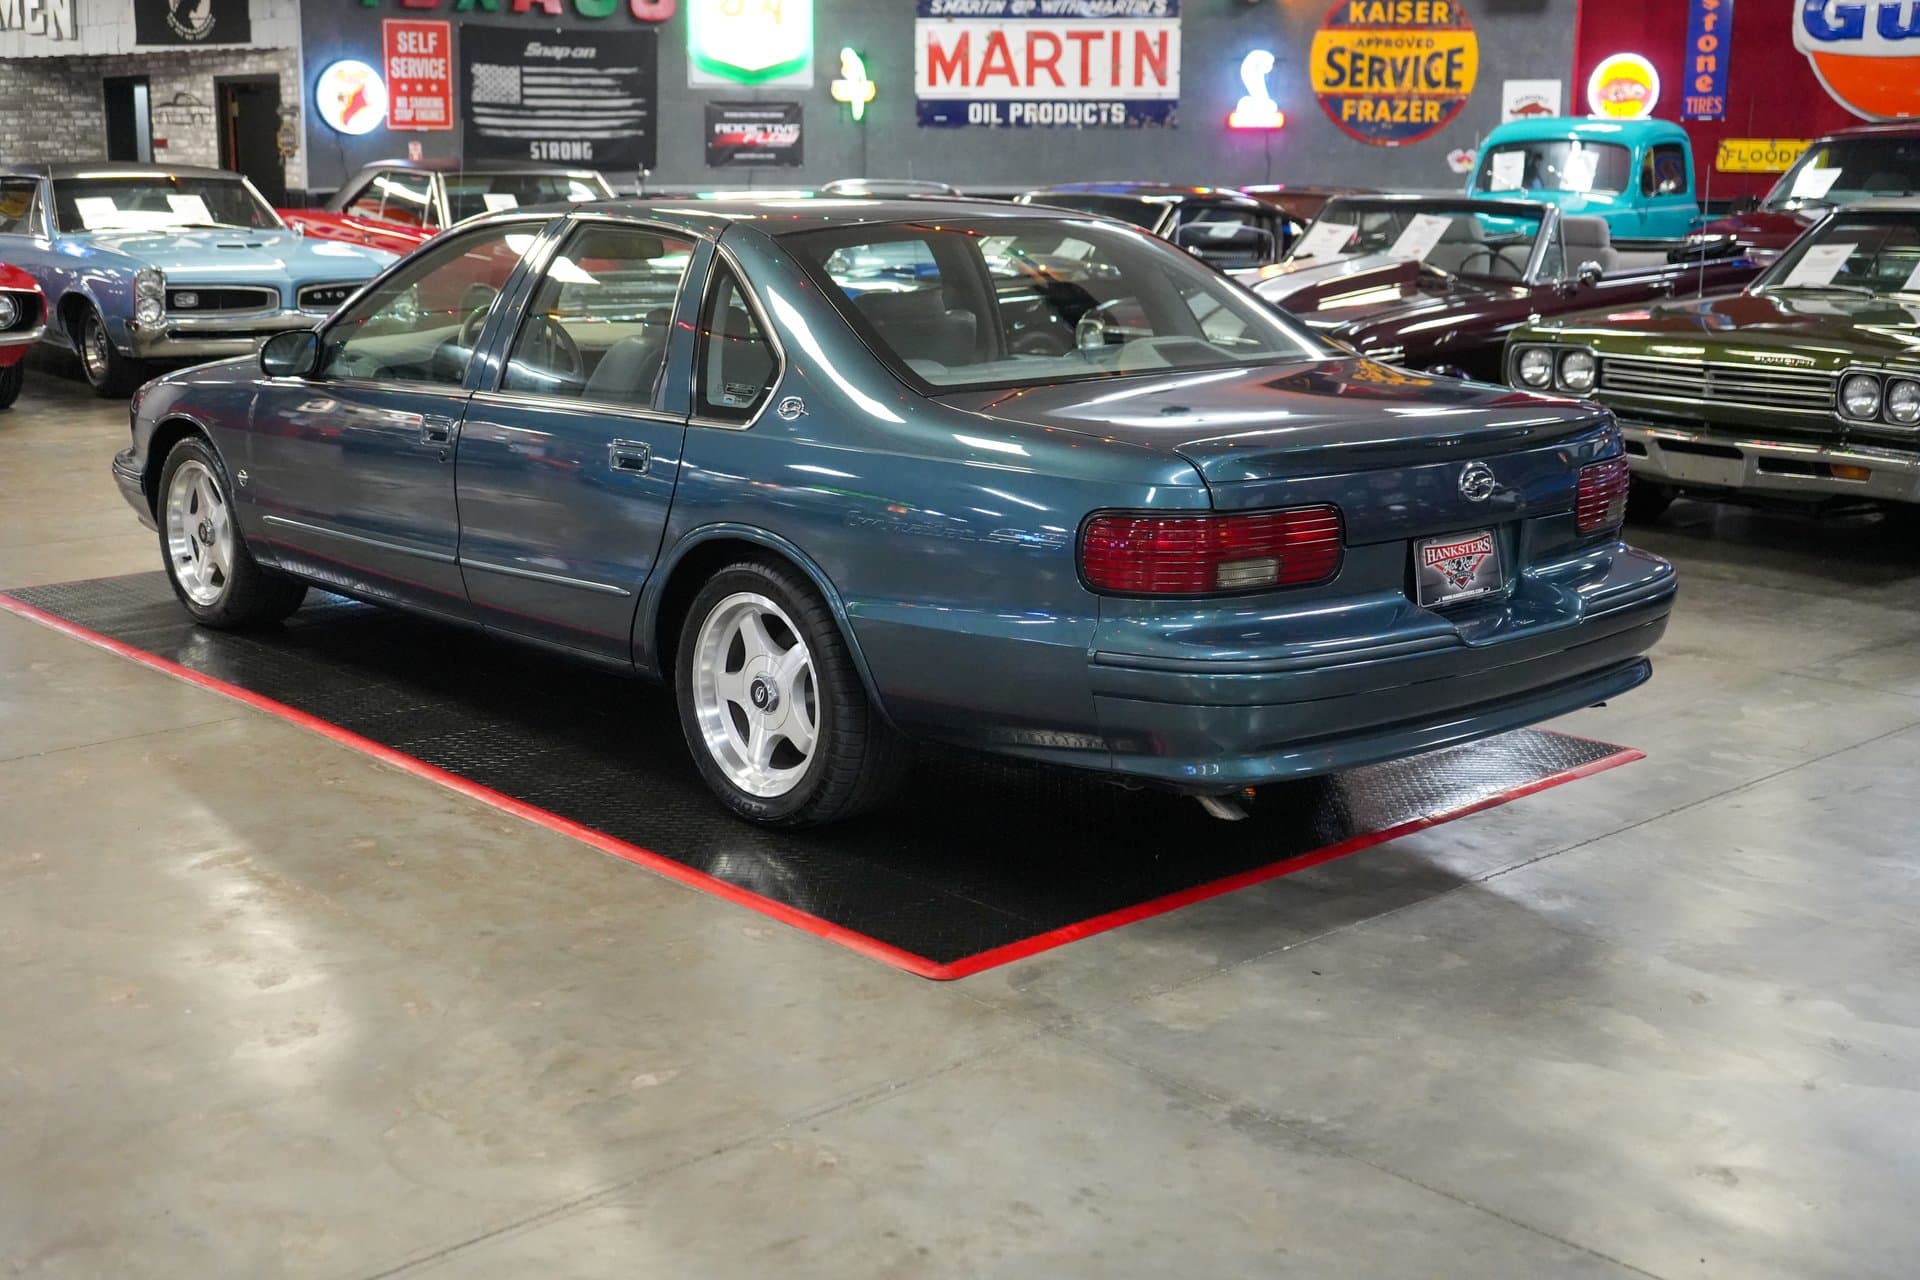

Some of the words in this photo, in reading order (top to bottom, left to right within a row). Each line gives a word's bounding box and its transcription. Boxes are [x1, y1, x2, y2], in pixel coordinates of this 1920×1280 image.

[1349, 0, 1450, 25] KAISER
[397, 32, 438, 53] SELF
[524, 42, 596, 60] Snap-on
[1355, 37, 1435, 49] APPROVED
[391, 57, 446, 80] SERVICE
[927, 30, 1169, 88] MARTIN
[1323, 46, 1465, 89] SERVICE
[968, 102, 1002, 124] OIL
[1009, 102, 1126, 124] PRODUCTS
[1341, 98, 1441, 123] FRAZER
[1685, 96, 1723, 115] TIRES
[530, 141, 593, 161] STRONG
[1426, 537, 1490, 564] HANKSTERS
